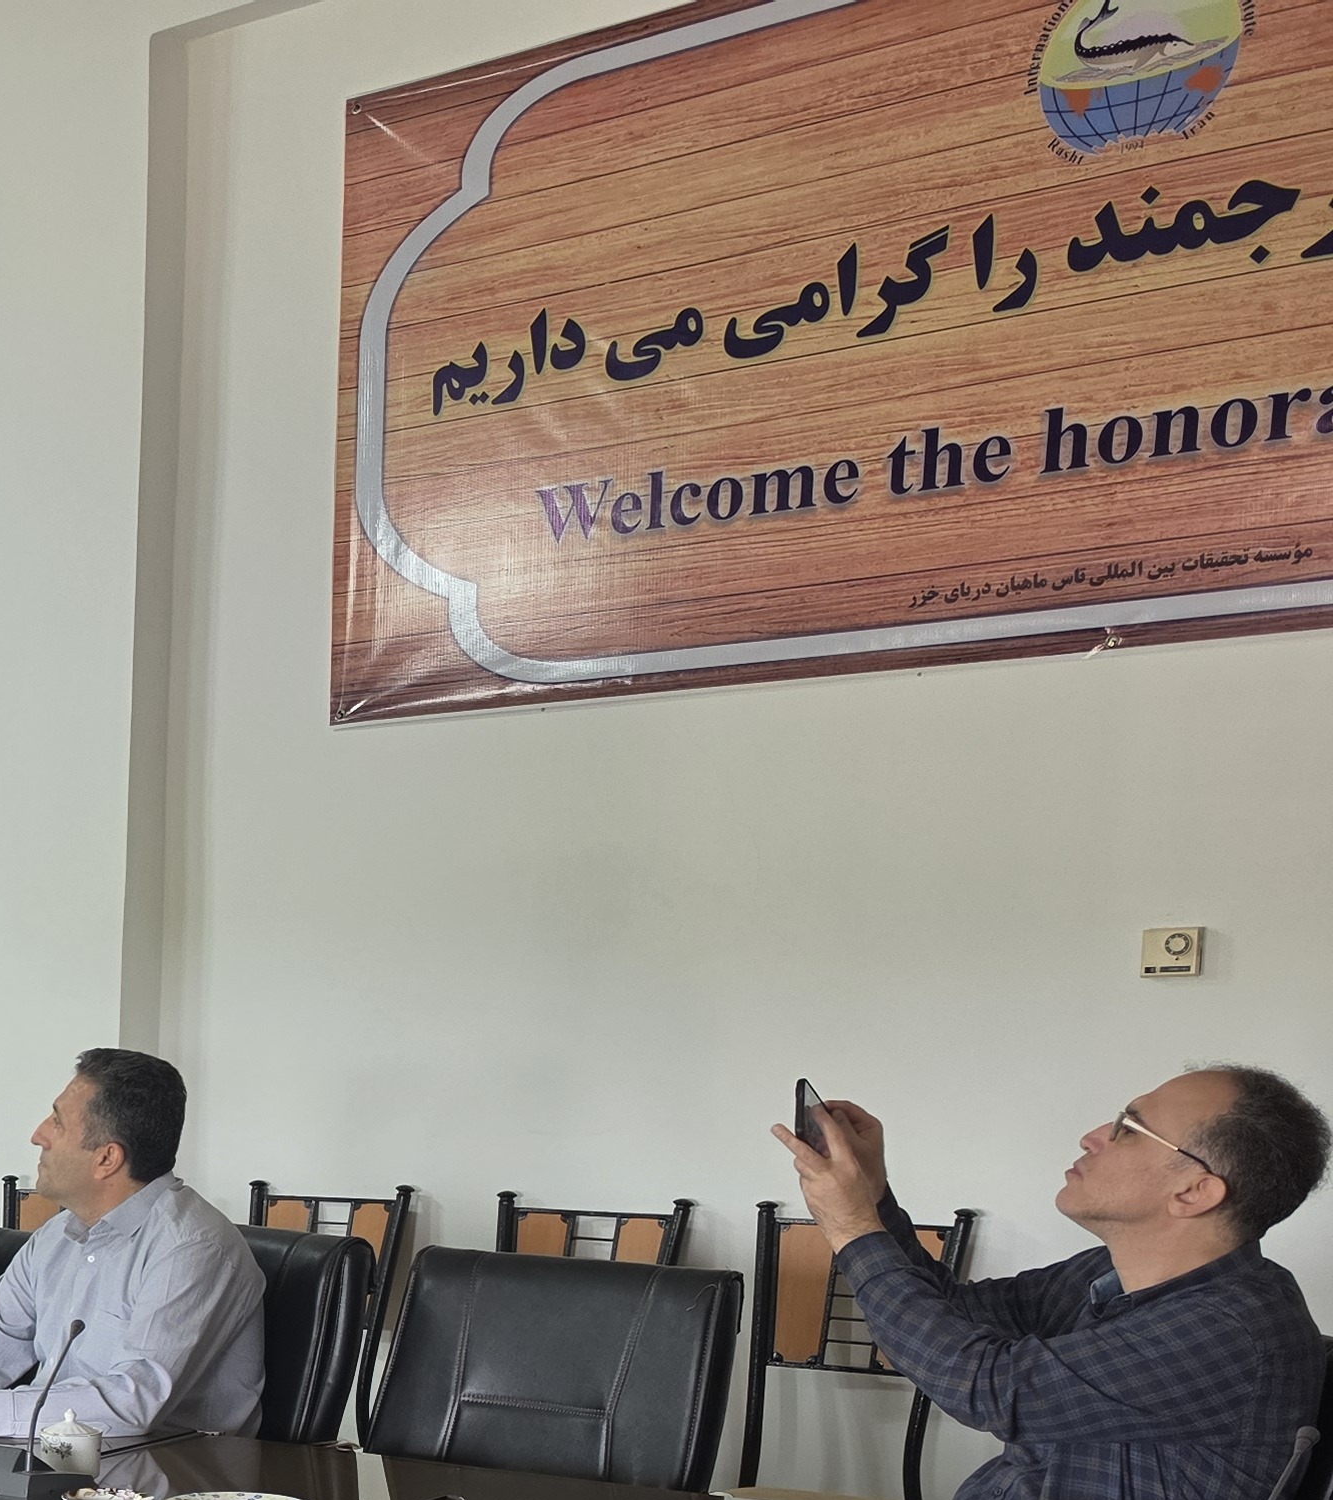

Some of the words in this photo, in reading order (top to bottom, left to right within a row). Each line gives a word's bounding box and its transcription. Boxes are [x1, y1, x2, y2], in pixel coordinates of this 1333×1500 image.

[1023, 0, 1074, 96] Internation
[1181, 109, 1215, 140] Iran
[1047, 137, 1085, 166] Rasht
[972, 213, 1038, 312] را
[723, 224, 949, 359] گرامی
[605, 307, 704, 381] می
[433, 307, 586, 416] داریم
[537, 456, 860, 544] Welcome
[886, 427, 1012, 496] the
[1147, 560, 1176, 580] بین
[1182, 547, 1250, 572] تحقیقات
[944, 581, 991, 604] دریای
[995, 573, 1048, 597] ماهیان
[1052, 567, 1086, 591] تاس
[908, 585, 939, 608] خزر
